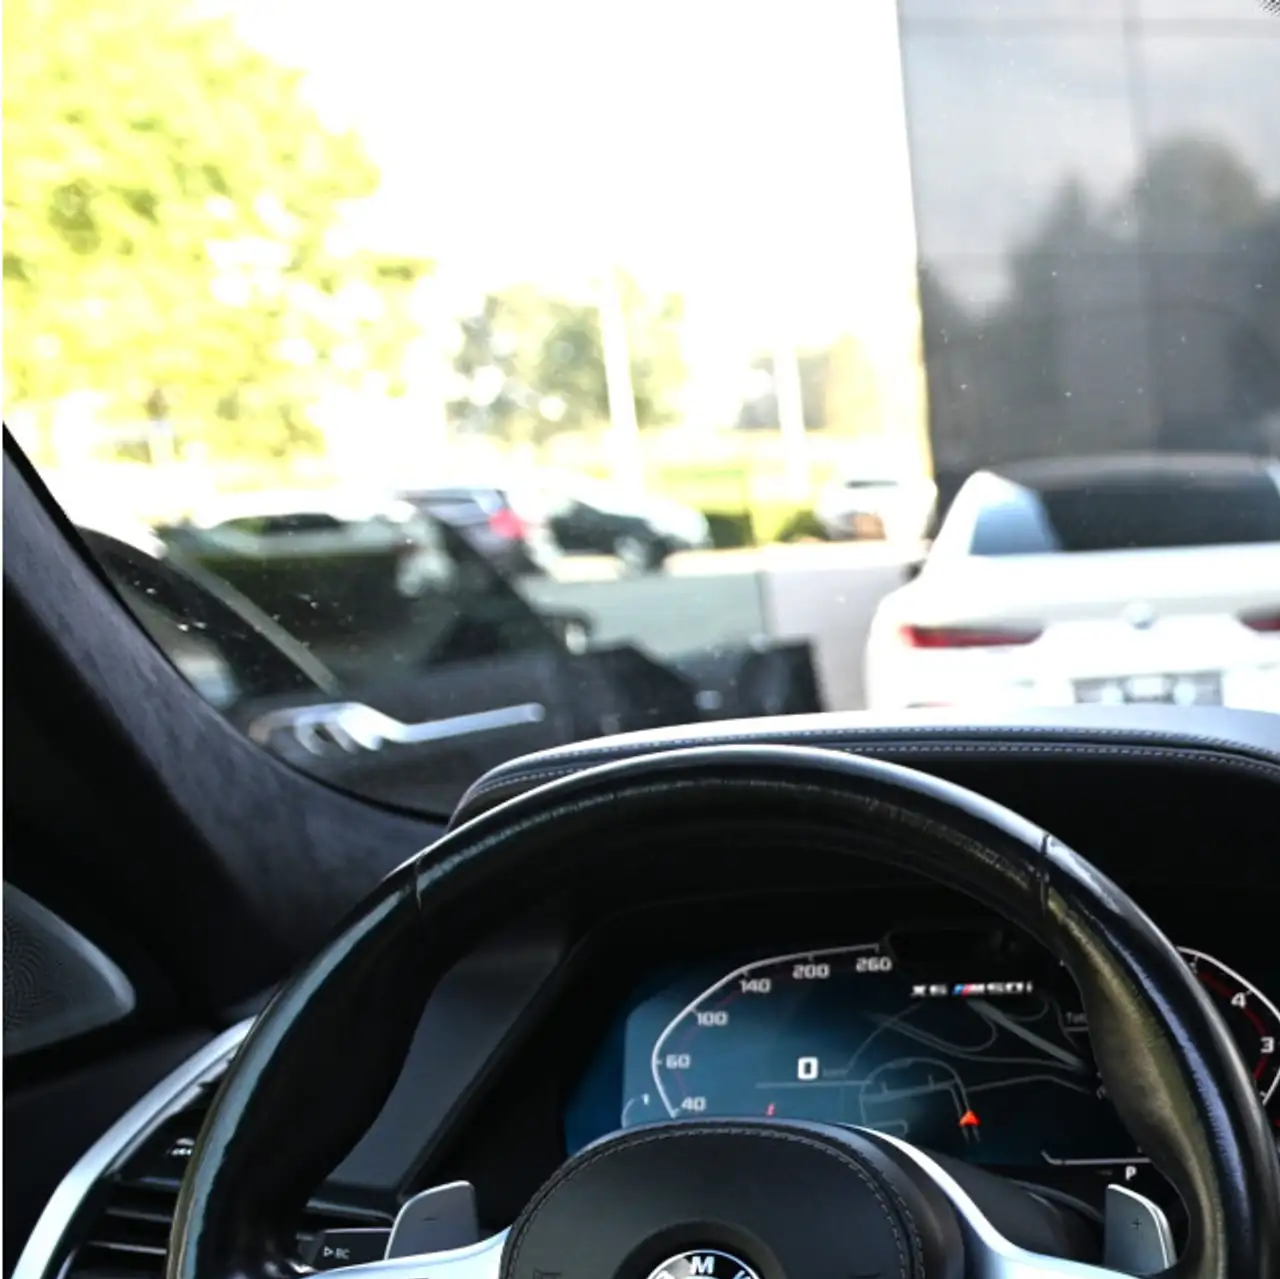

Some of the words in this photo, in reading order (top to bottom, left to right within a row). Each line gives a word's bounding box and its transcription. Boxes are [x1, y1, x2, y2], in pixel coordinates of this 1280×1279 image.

[792, 963, 830, 979] 200
[855, 957, 892, 972] 260
[739, 978, 771, 994] 140
[1230, 992, 1247, 1009] 4
[696, 1011, 728, 1027] 100
[1259, 1036, 1275, 1054] 3
[665, 1053, 691, 1069] 60
[797, 1056, 819, 1081] 0
[681, 1097, 707, 1112] 40
[1125, 1166, 1137, 1181] P
